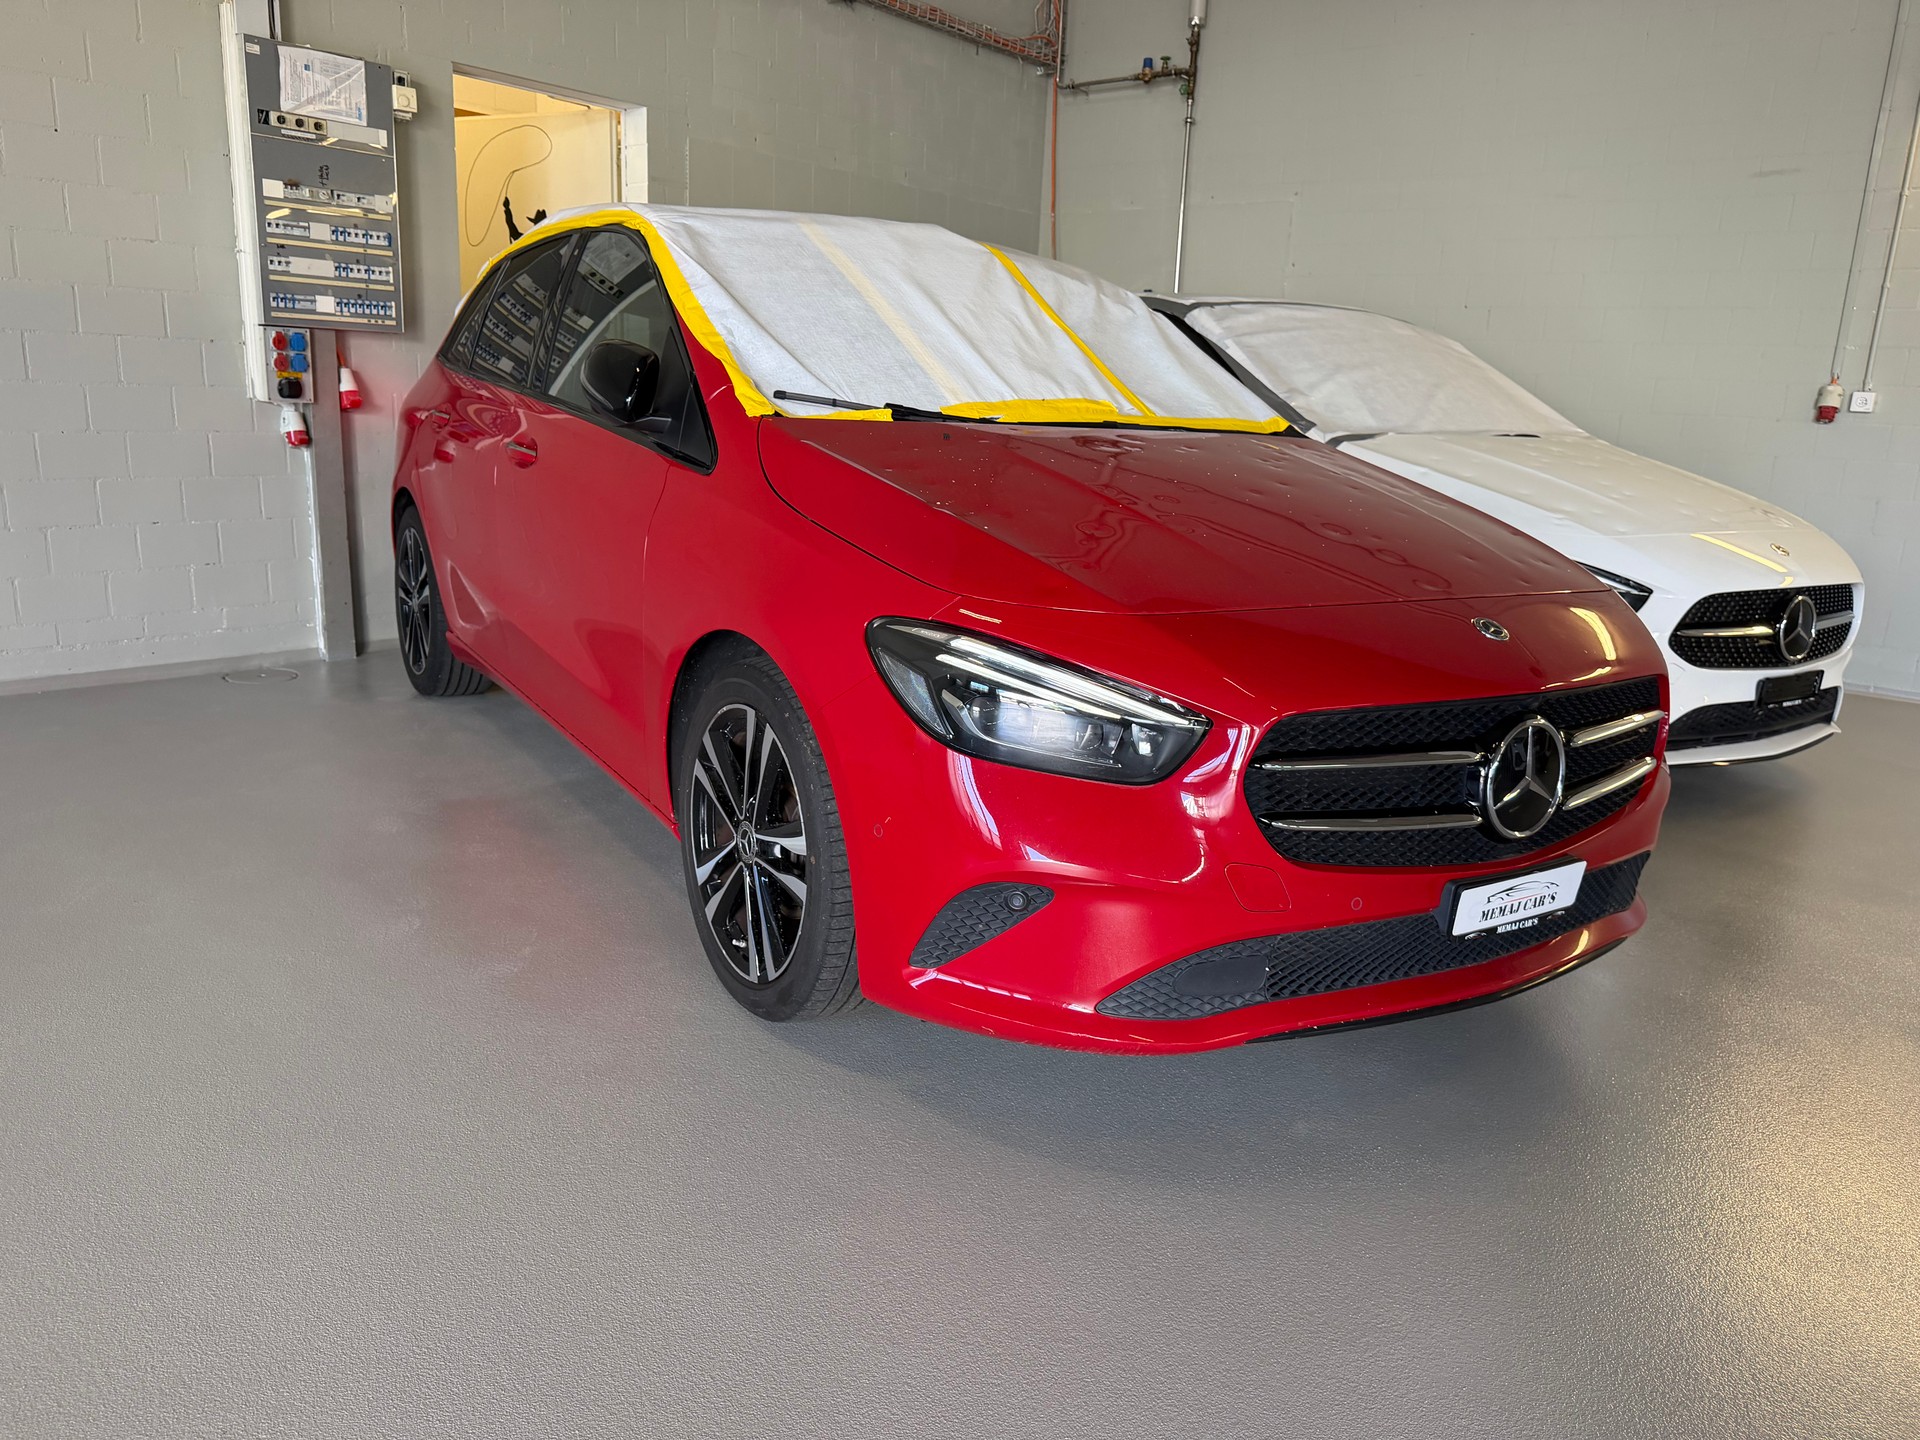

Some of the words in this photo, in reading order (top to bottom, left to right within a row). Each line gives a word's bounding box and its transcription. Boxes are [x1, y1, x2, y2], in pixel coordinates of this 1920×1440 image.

[1479, 901, 1521, 922] MEMAJ
[1522, 891, 1557, 910] CAR'S
[1496, 921, 1519, 934] MEMAJ
[1519, 917, 1539, 930] CAR'S
